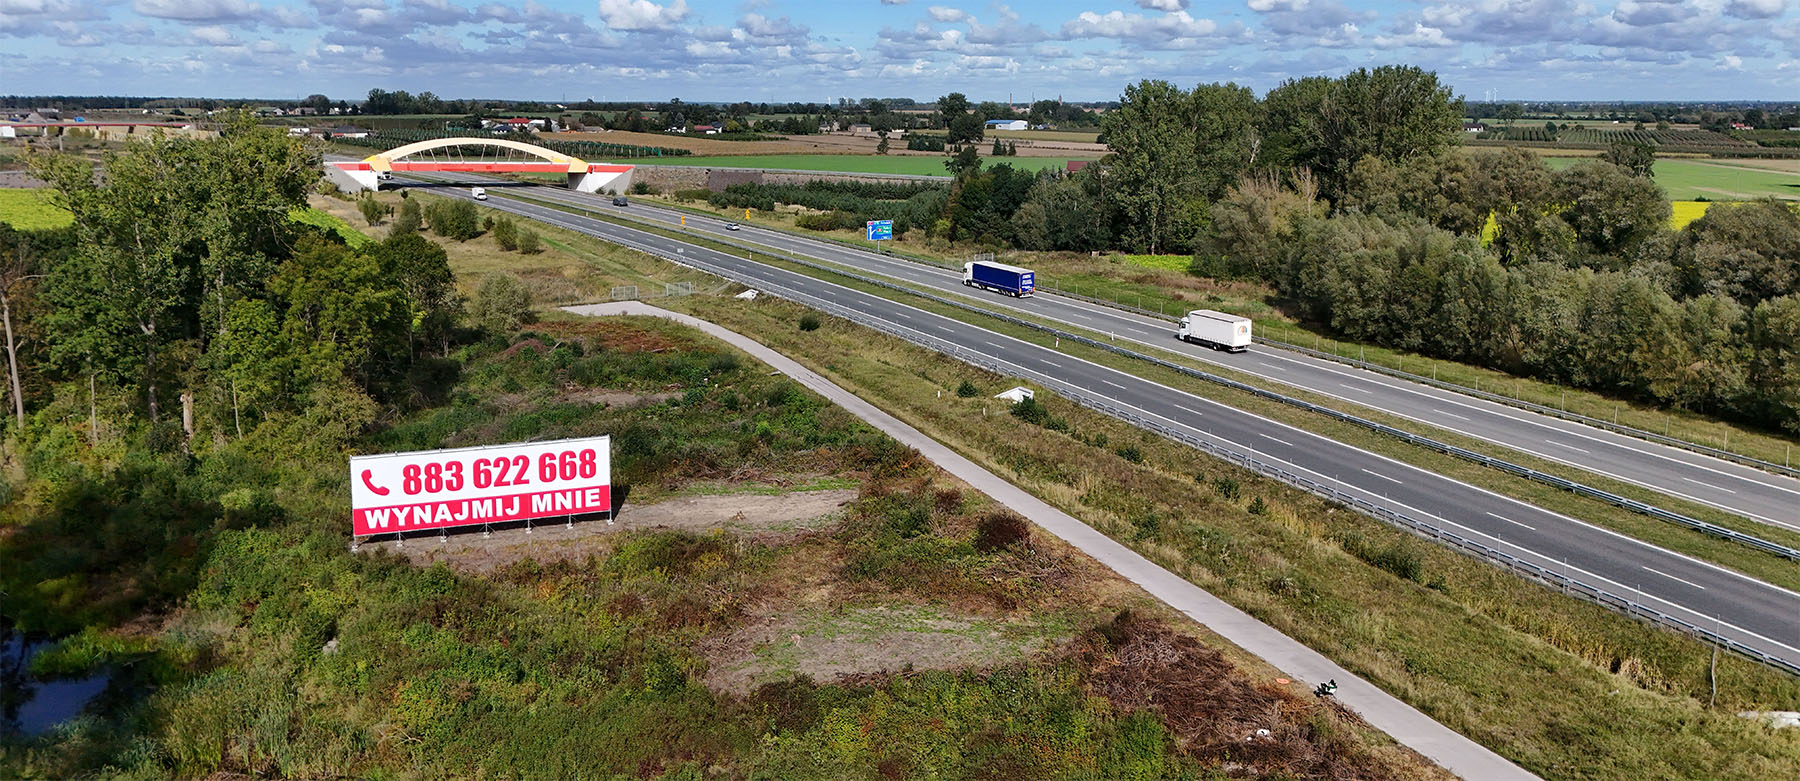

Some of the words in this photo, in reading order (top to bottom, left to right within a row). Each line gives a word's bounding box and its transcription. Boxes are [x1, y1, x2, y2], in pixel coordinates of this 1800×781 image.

[402, 460, 464, 496] 883
[472, 454, 530, 489] 622
[538, 448, 597, 482] 668
[364, 496, 520, 529] WYNAJMIJ
[531, 488, 601, 514] MNIE
